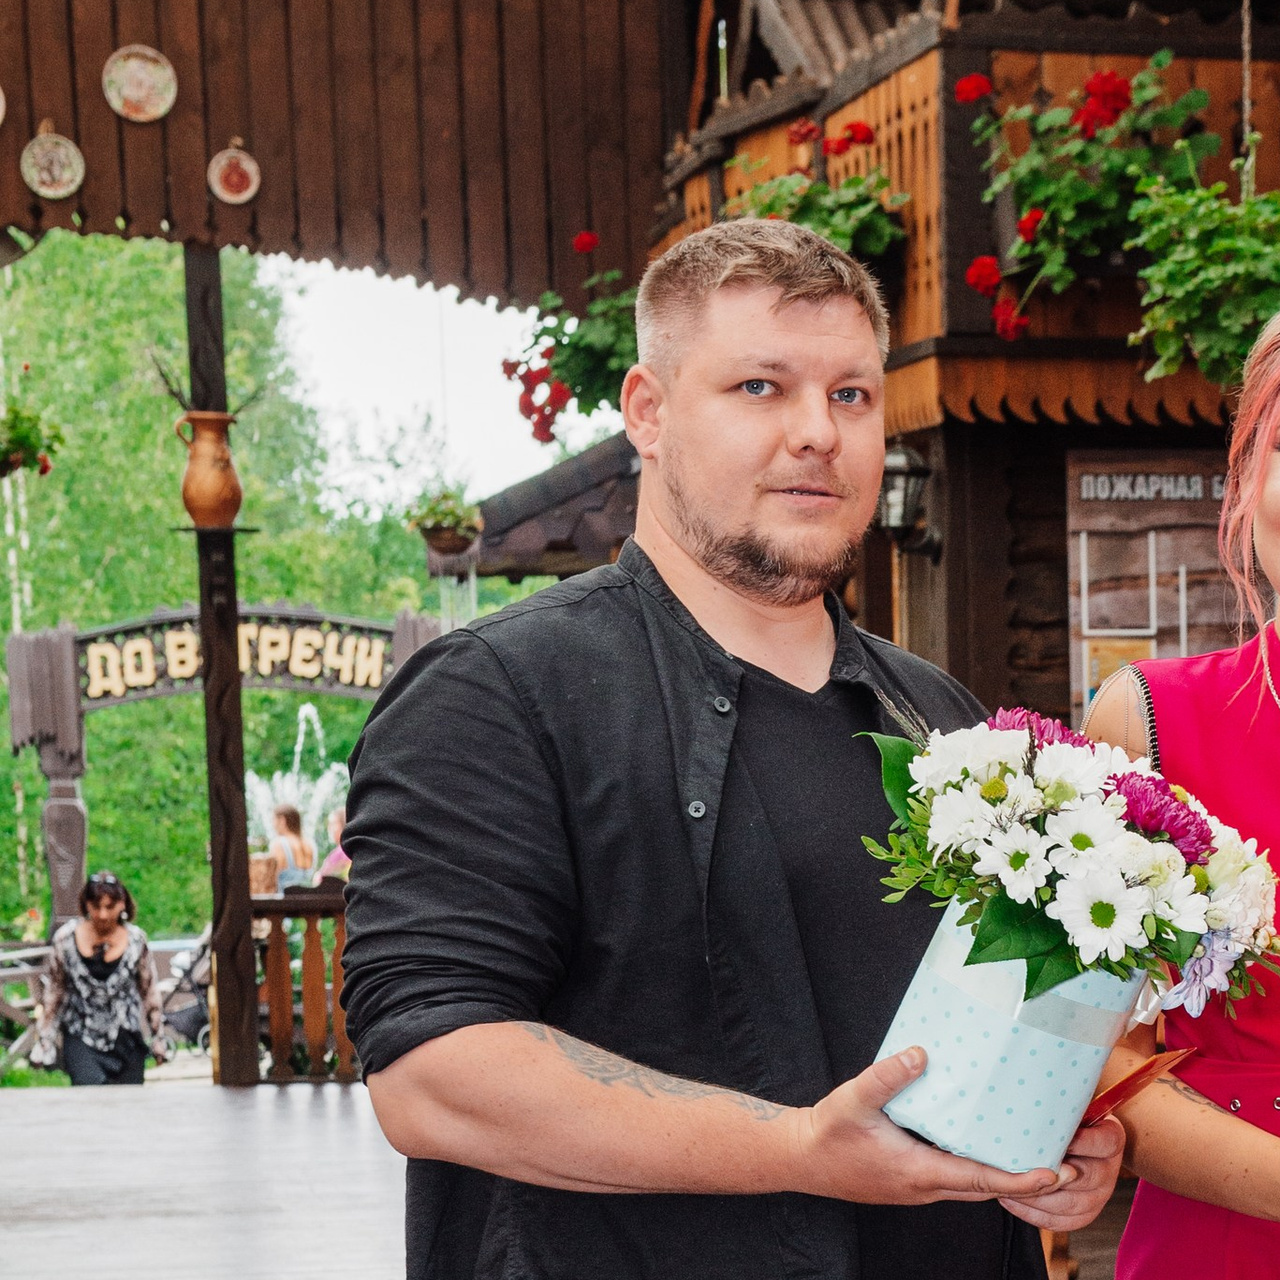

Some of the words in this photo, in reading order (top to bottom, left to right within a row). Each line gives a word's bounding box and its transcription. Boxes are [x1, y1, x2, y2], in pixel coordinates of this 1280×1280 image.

[1080, 474, 1203, 500] ПОЖАРНАЯ
[86, 637, 157, 698] ДО
[165, 622, 386, 688] ВТРЕЧИ
